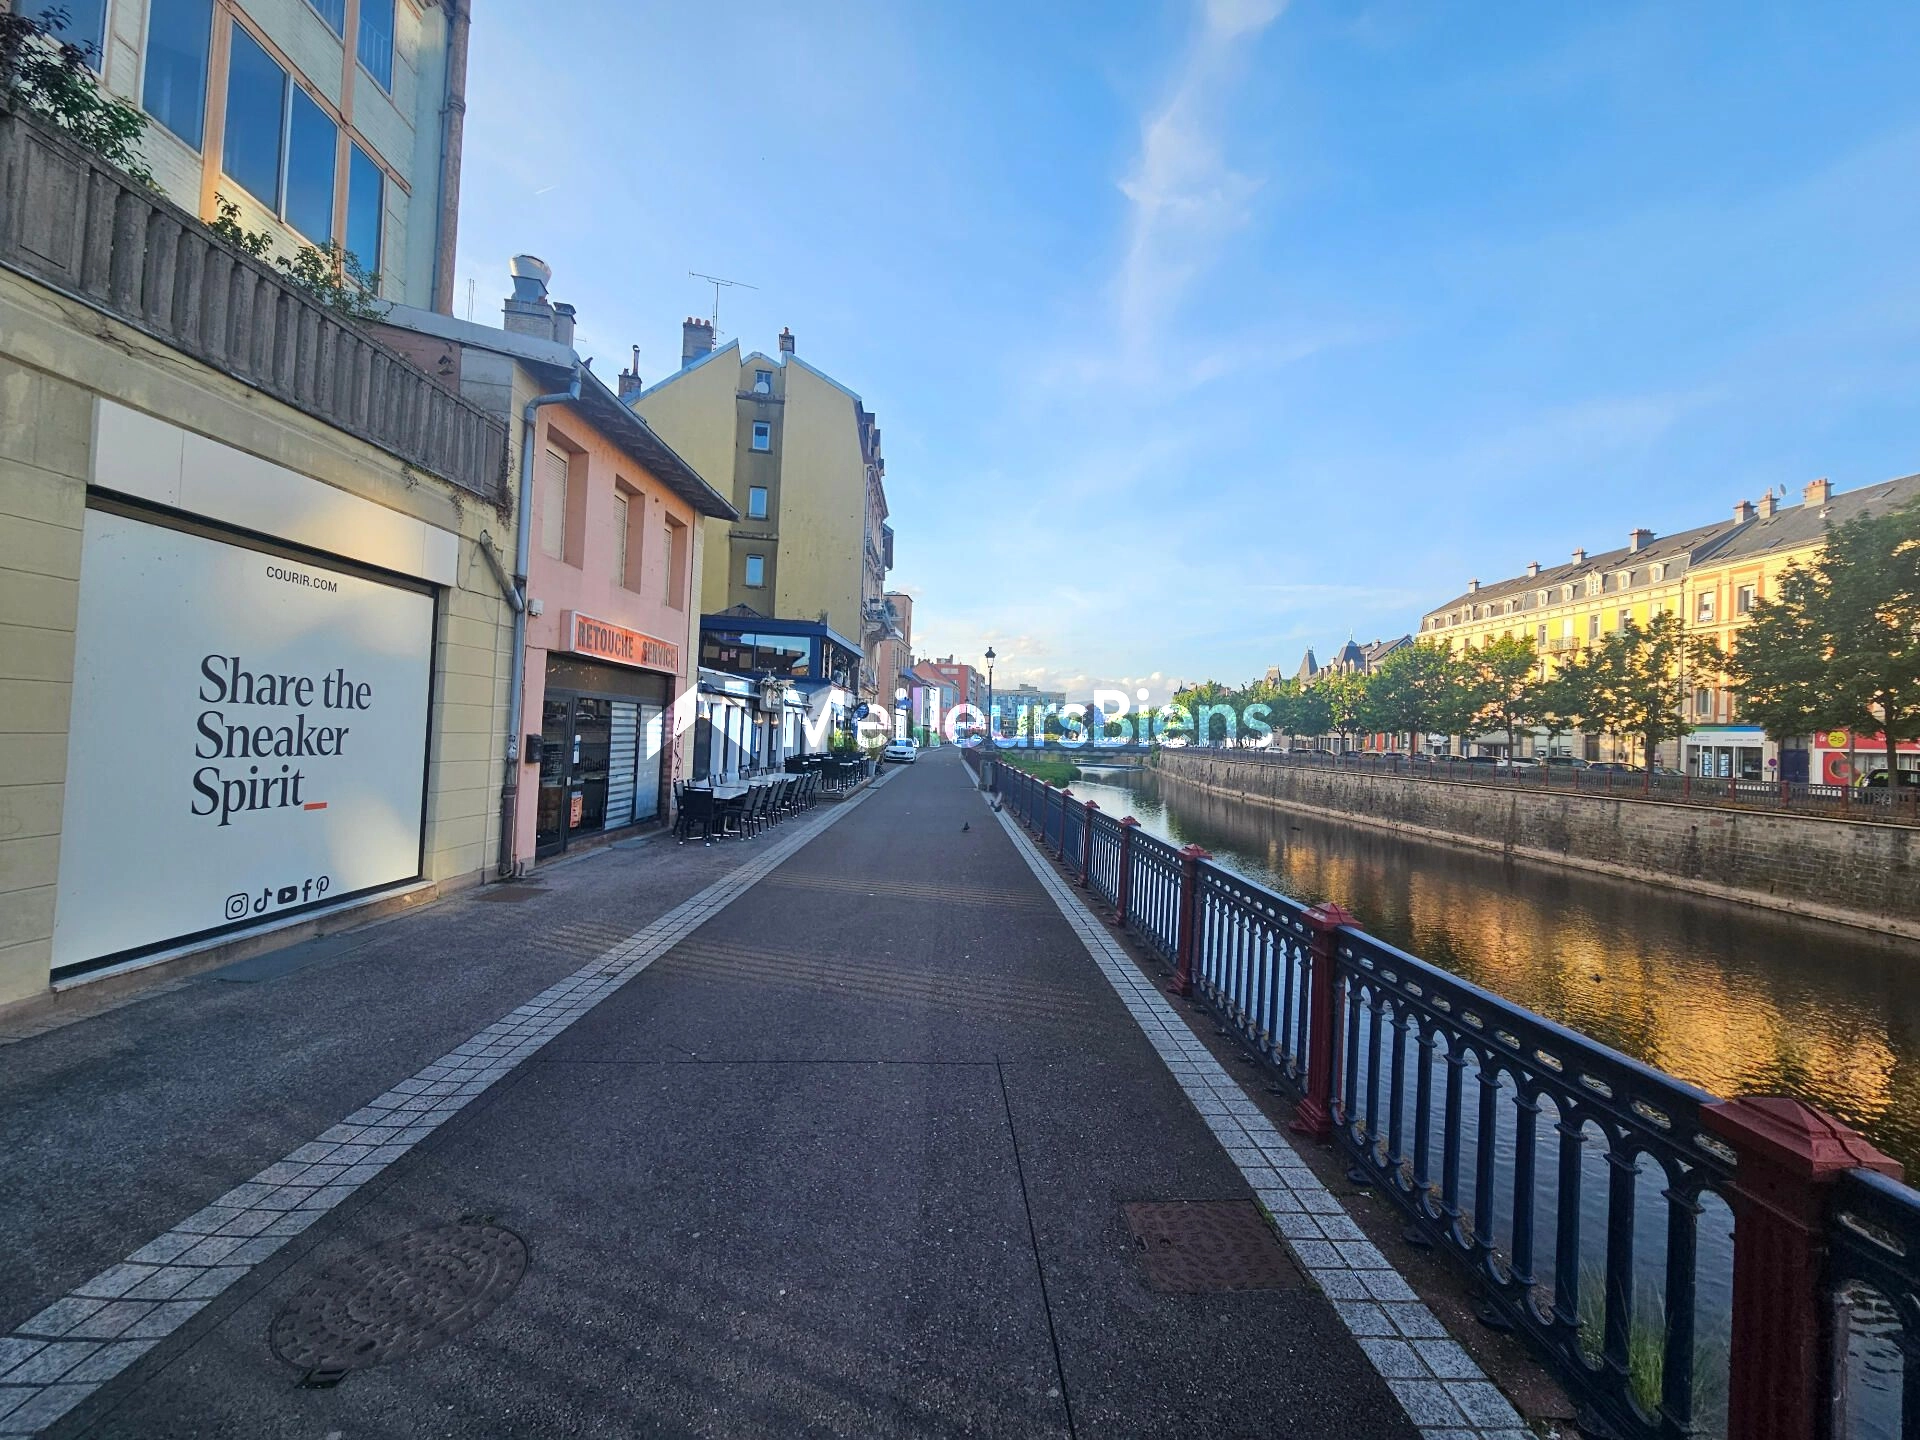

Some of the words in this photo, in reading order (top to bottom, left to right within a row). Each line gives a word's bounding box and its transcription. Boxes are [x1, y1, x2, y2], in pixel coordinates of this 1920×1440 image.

[266, 566, 338, 593] COURIR.COM
[577, 621, 634, 659] RETOUCHE
[641, 641, 676, 669] SERVICE
[199, 654, 314, 708] Share
[322, 668, 372, 710] the
[195, 710, 350, 759] Sneaker
